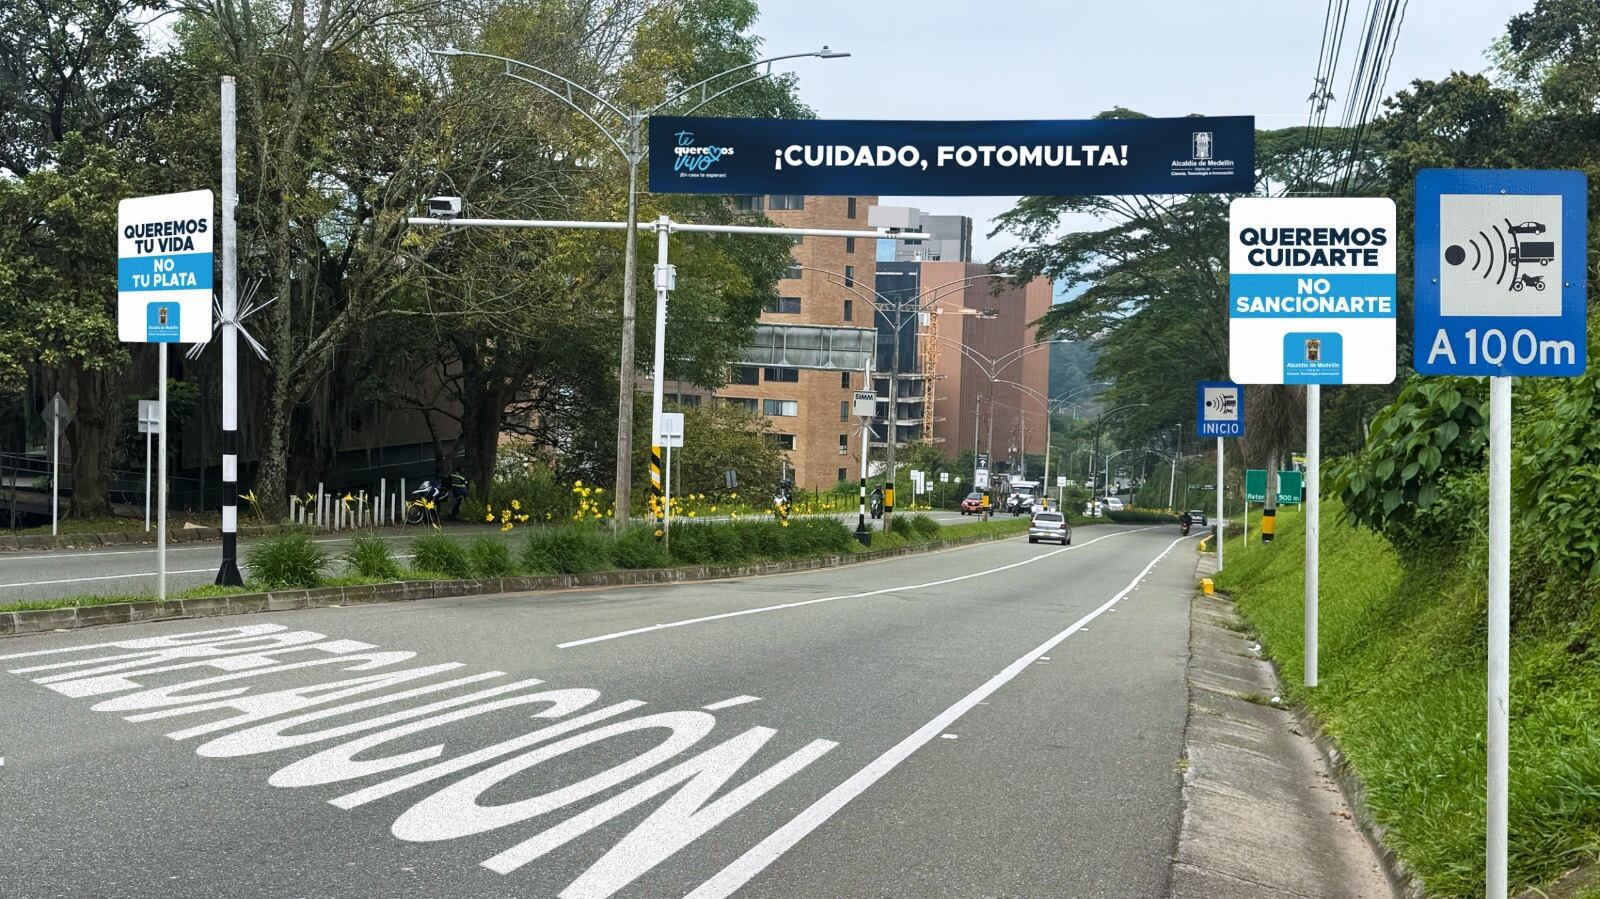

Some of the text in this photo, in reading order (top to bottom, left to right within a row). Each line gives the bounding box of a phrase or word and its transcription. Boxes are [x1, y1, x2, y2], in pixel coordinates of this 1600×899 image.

[674, 130, 695, 146] te
[774, 144, 1128, 171] ¡CUIDADO, FOTOMULTA!
[124, 218, 208, 239] QUEREMOS
[1239, 227, 1387, 246] QUEREMOS
[135, 235, 195, 254] TU VIDA
[153, 258, 174, 273] NO
[1247, 248, 1379, 267] CUIDARTE
[132, 272, 197, 288] TU PLATA
[1297, 278, 1331, 295] NO
[1236, 296, 1392, 313] SANCIONARTE
[1427, 328, 1576, 365] A 100m
[1203, 423, 1239, 434] INICIO
[0, 623, 839, 899] PRECAUCIÓN
